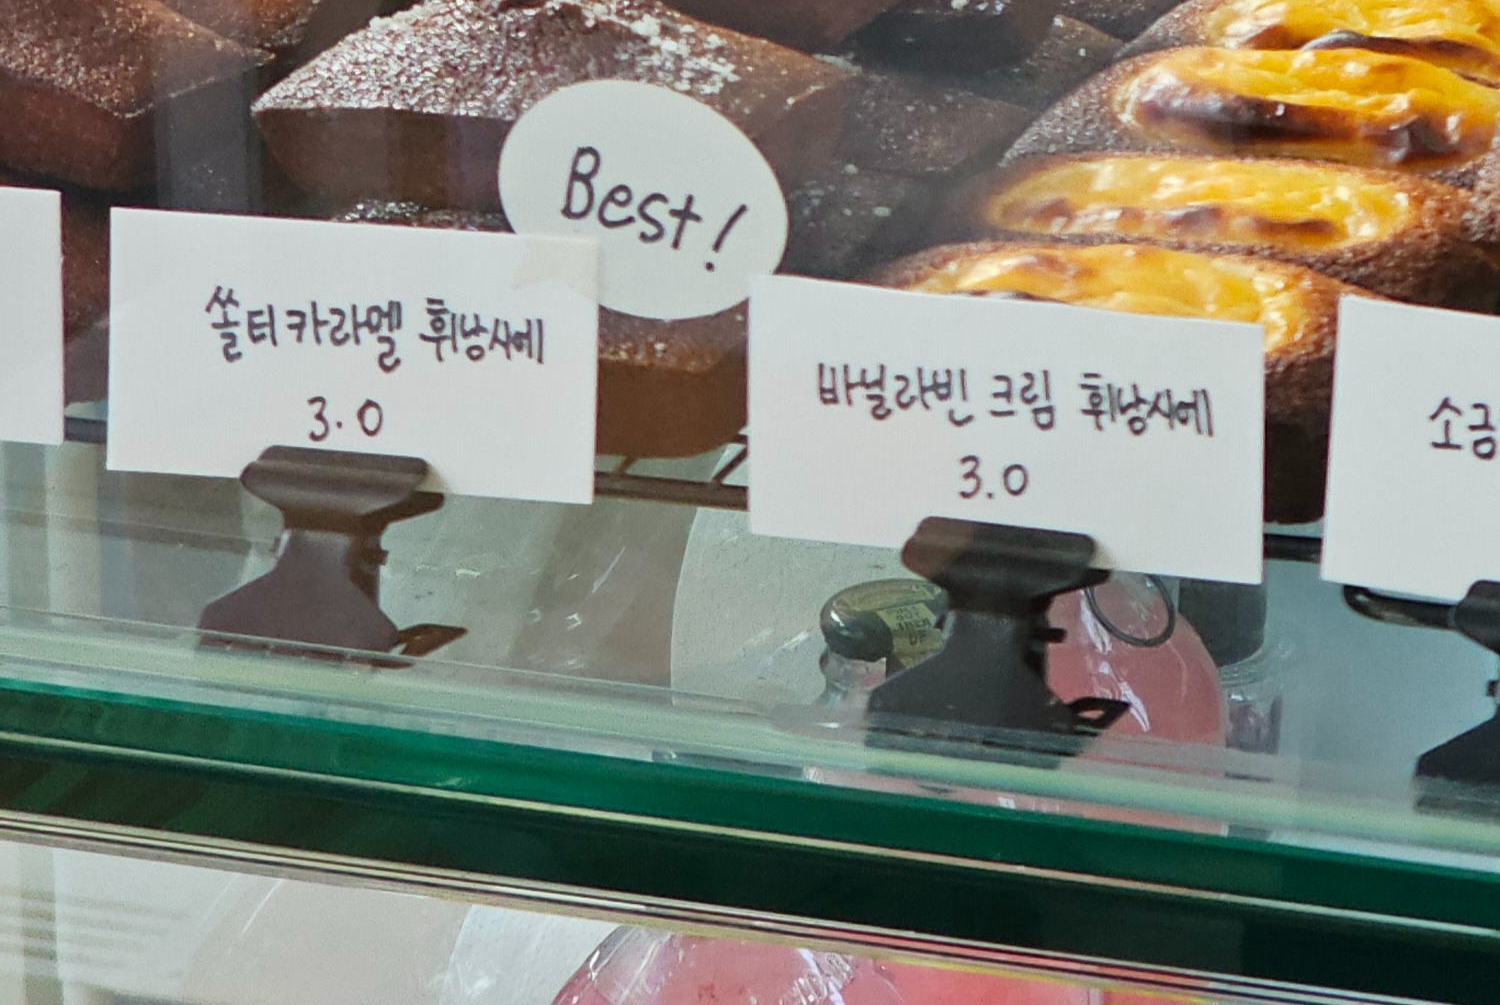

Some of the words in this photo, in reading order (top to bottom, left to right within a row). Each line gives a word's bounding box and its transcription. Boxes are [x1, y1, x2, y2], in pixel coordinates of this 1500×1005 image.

[560, 146, 748, 272] Best!
[418, 297, 544, 365] 휘낭시에
[306, 395, 384, 443] 3.0
[817, 362, 975, 428] 바닐라빈
[988, 369, 1056, 432] 크림
[1078, 372, 1214, 438] 휘낭시에
[958, 454, 1029, 500] 3.0
